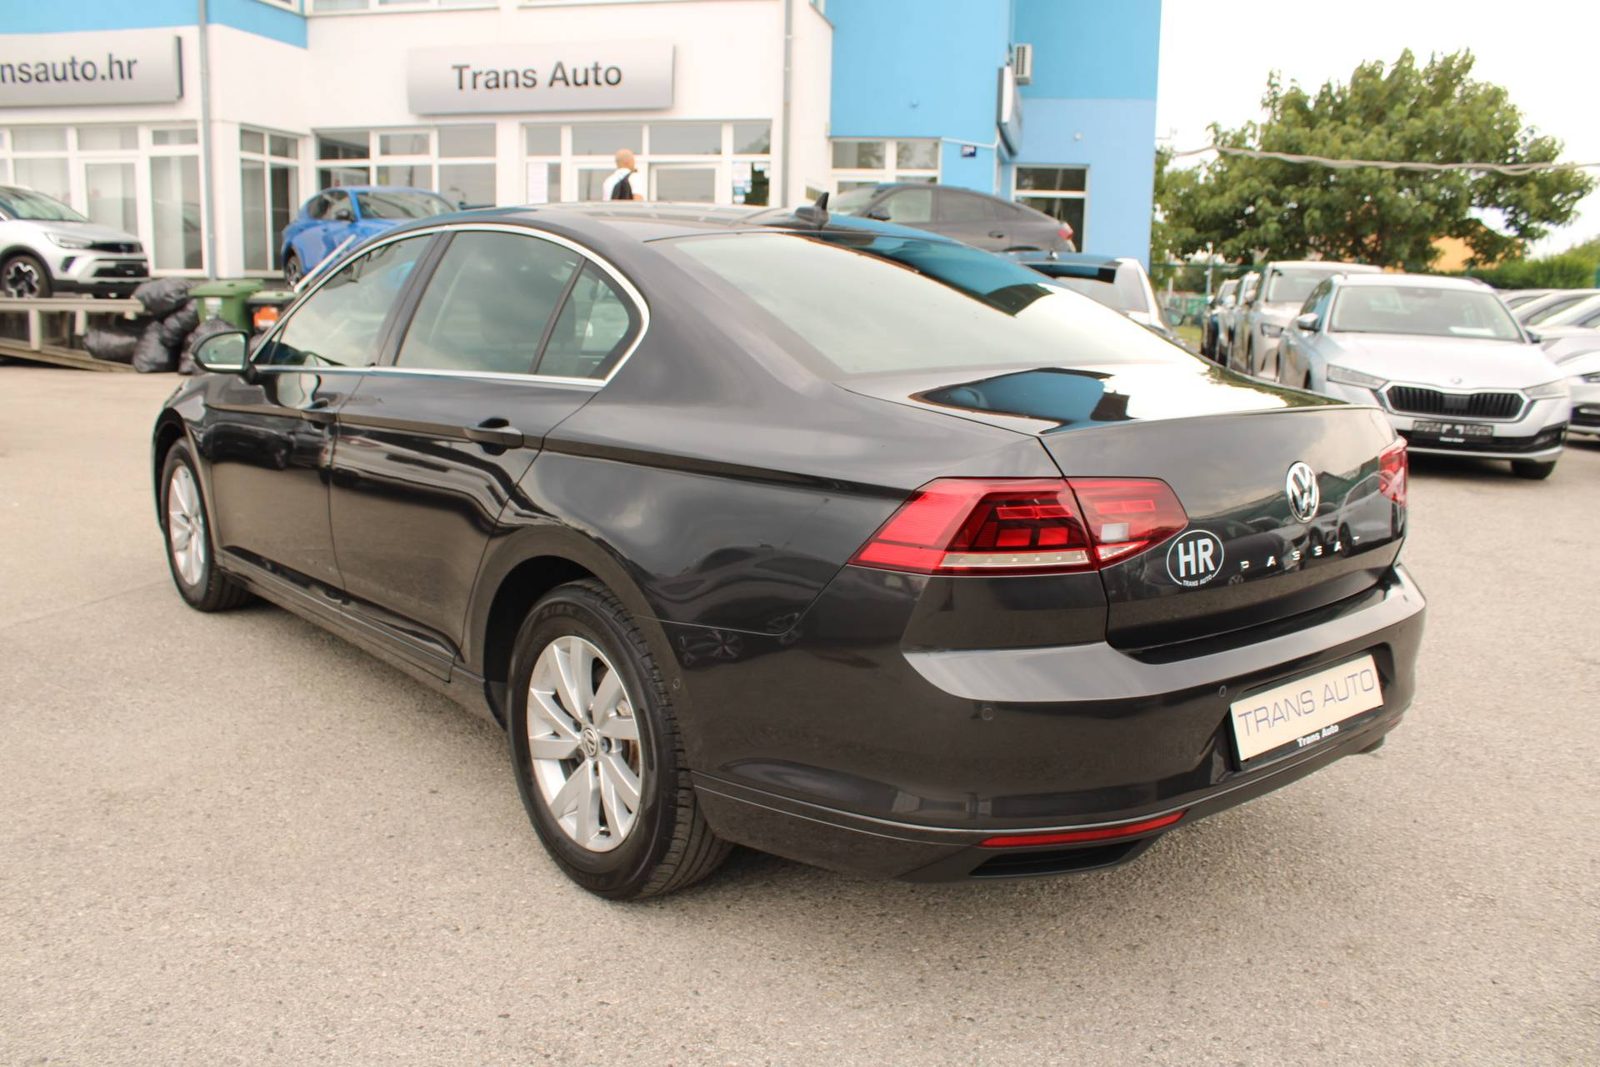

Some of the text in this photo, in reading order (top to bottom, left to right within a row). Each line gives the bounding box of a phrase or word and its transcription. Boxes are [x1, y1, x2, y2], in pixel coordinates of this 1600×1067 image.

[0, 53, 138, 84] nsauto.hr
[452, 61, 623, 90] Trans Auto
[1177, 538, 1216, 577] HR
[1240, 535, 1360, 572] PASSAT
[1238, 668, 1375, 737] TRANS AUTO
[1297, 724, 1340, 748] Trans Auto
